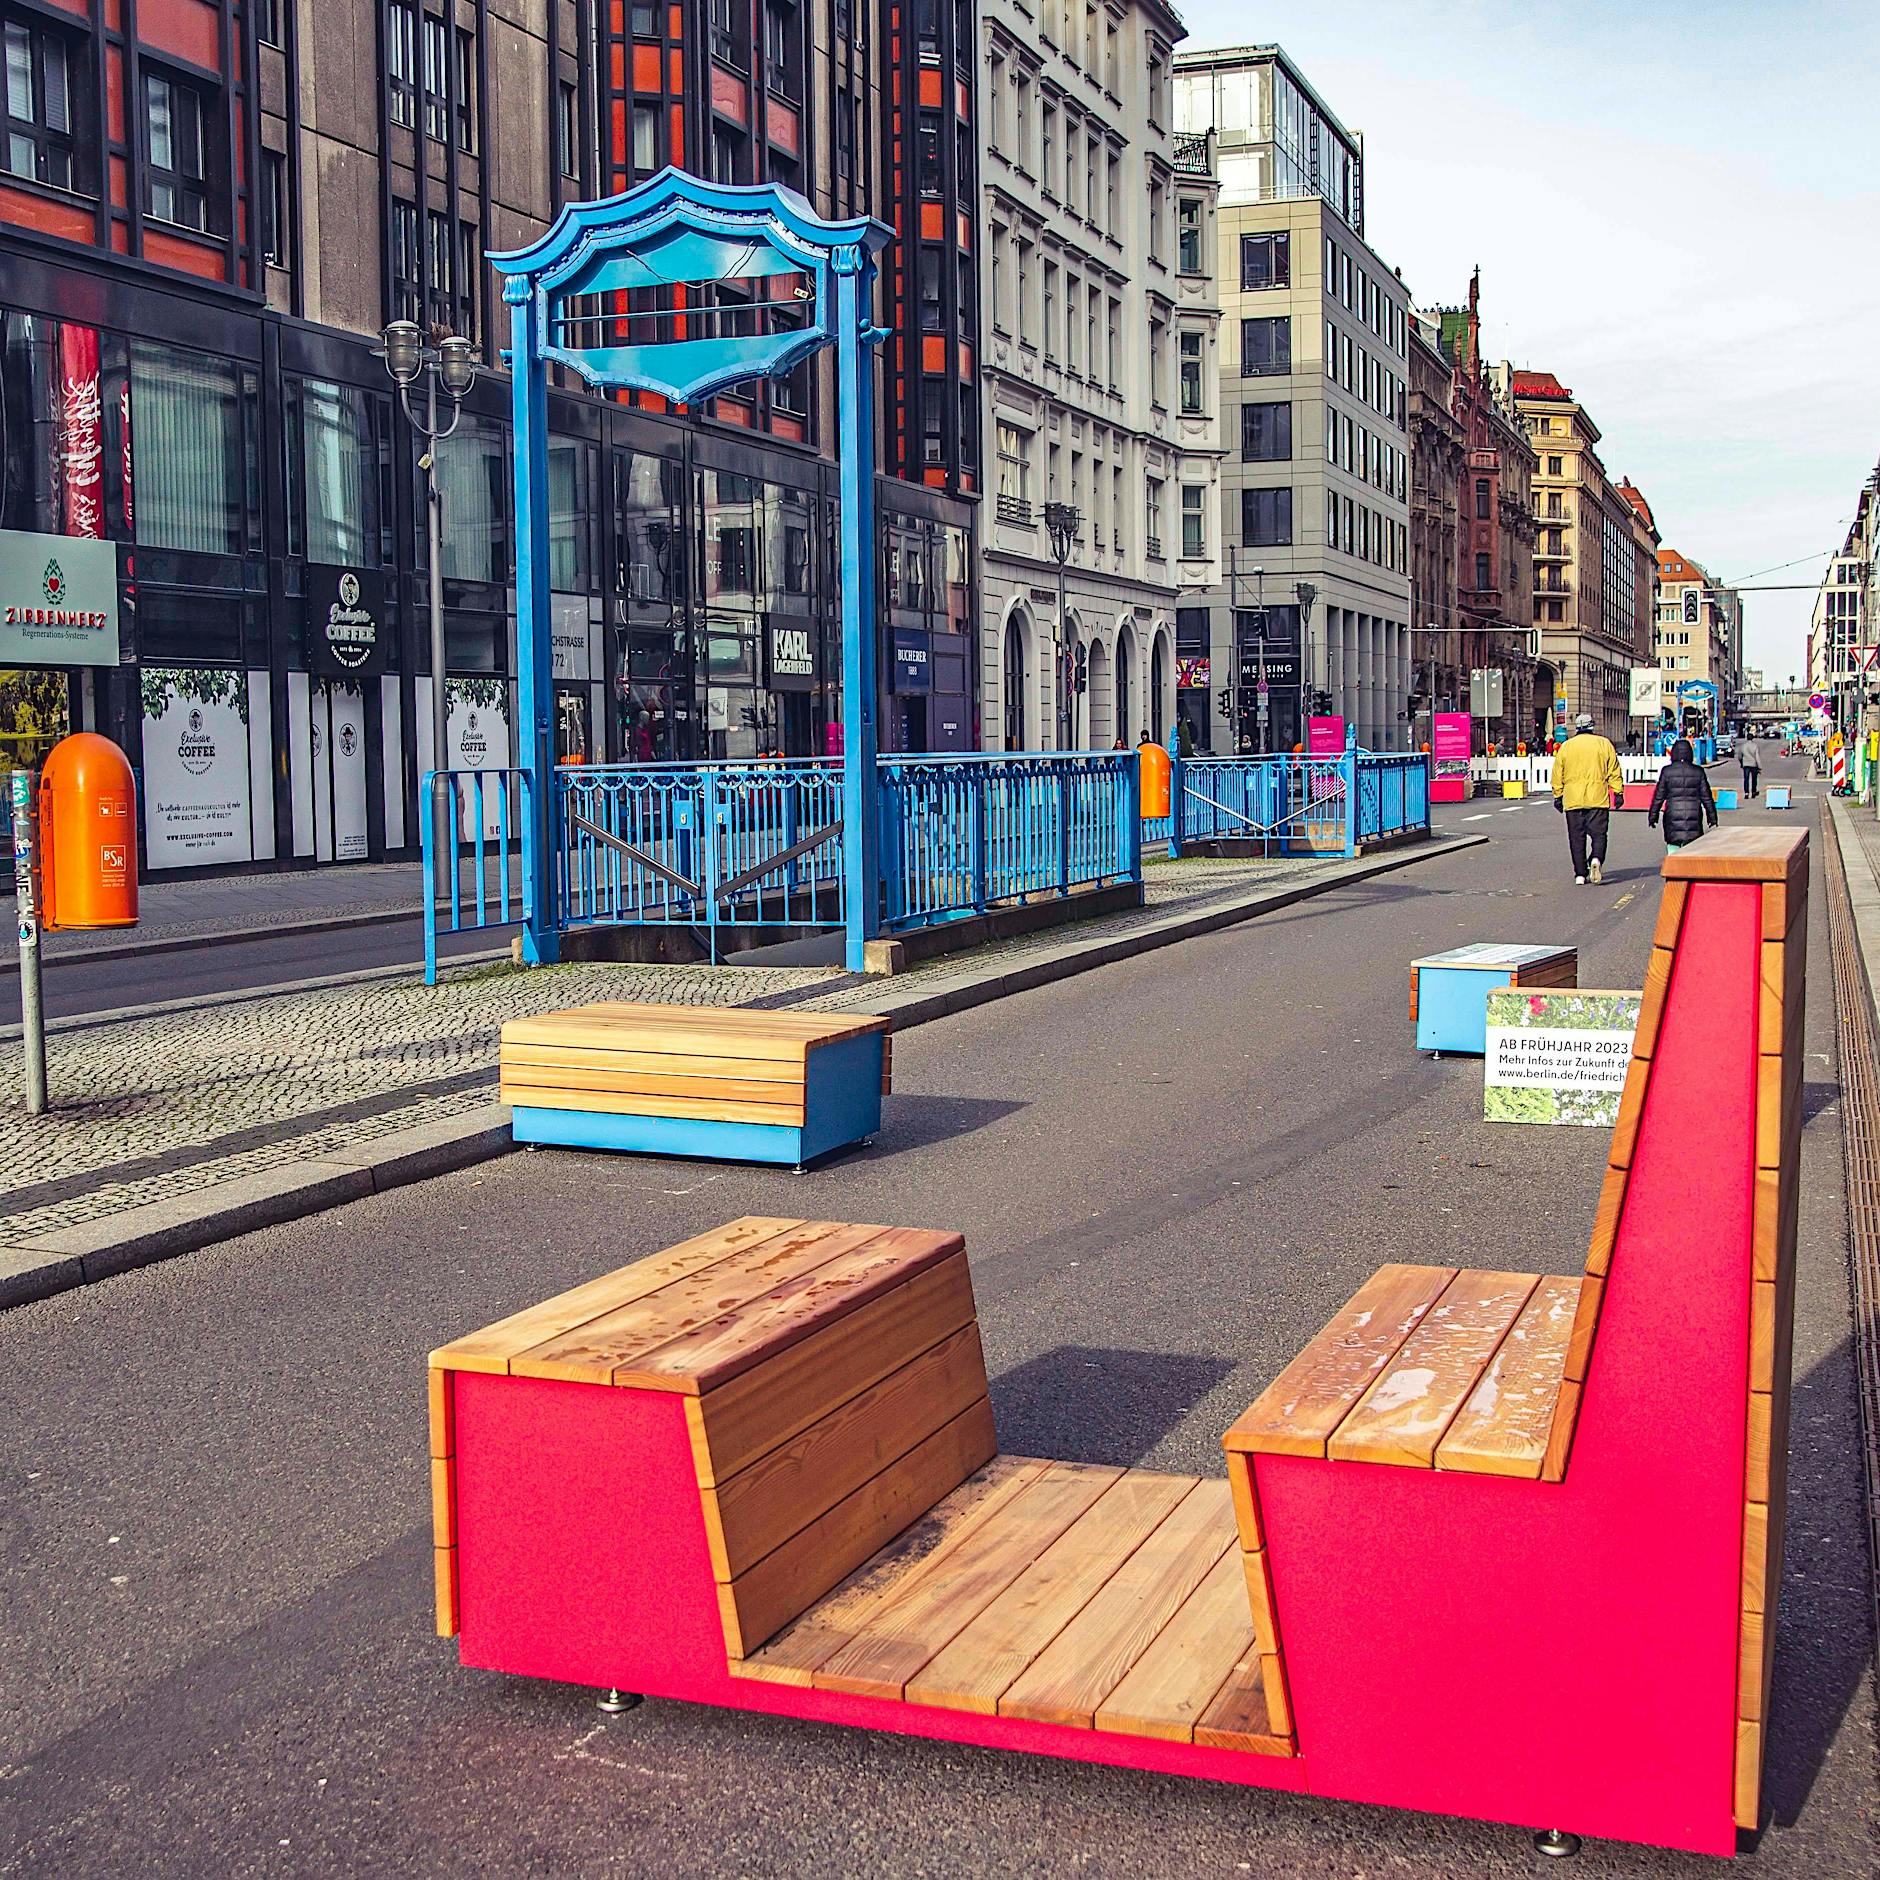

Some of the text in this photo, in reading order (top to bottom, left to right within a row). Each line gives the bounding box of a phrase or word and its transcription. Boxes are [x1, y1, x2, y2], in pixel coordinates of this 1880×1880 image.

[5, 607, 107, 629] ZIRBENHERZ
[22, 628, 89, 641] Regenerations-Systeme
[326, 624, 376, 643] COFFEE
[551, 635, 585, 648] CHSTRASSE
[773, 628, 813, 661] KARL
[897, 649, 927, 663] BUCHERER
[1242, 665, 1292, 673] MESING
[178, 745, 215, 758] COFFEE
[460, 742, 487, 752] COFFEE
[104, 850, 124, 867] BSR
[1499, 1036, 1629, 1054] AB FRÜHJAHR 2023
[1499, 1054, 1526, 1064] Mehr
[1528, 1055, 1553, 1066] Infos
[1556, 1059, 1572, 1067] zur
[1575, 1057, 1615, 1068] Zukunft
